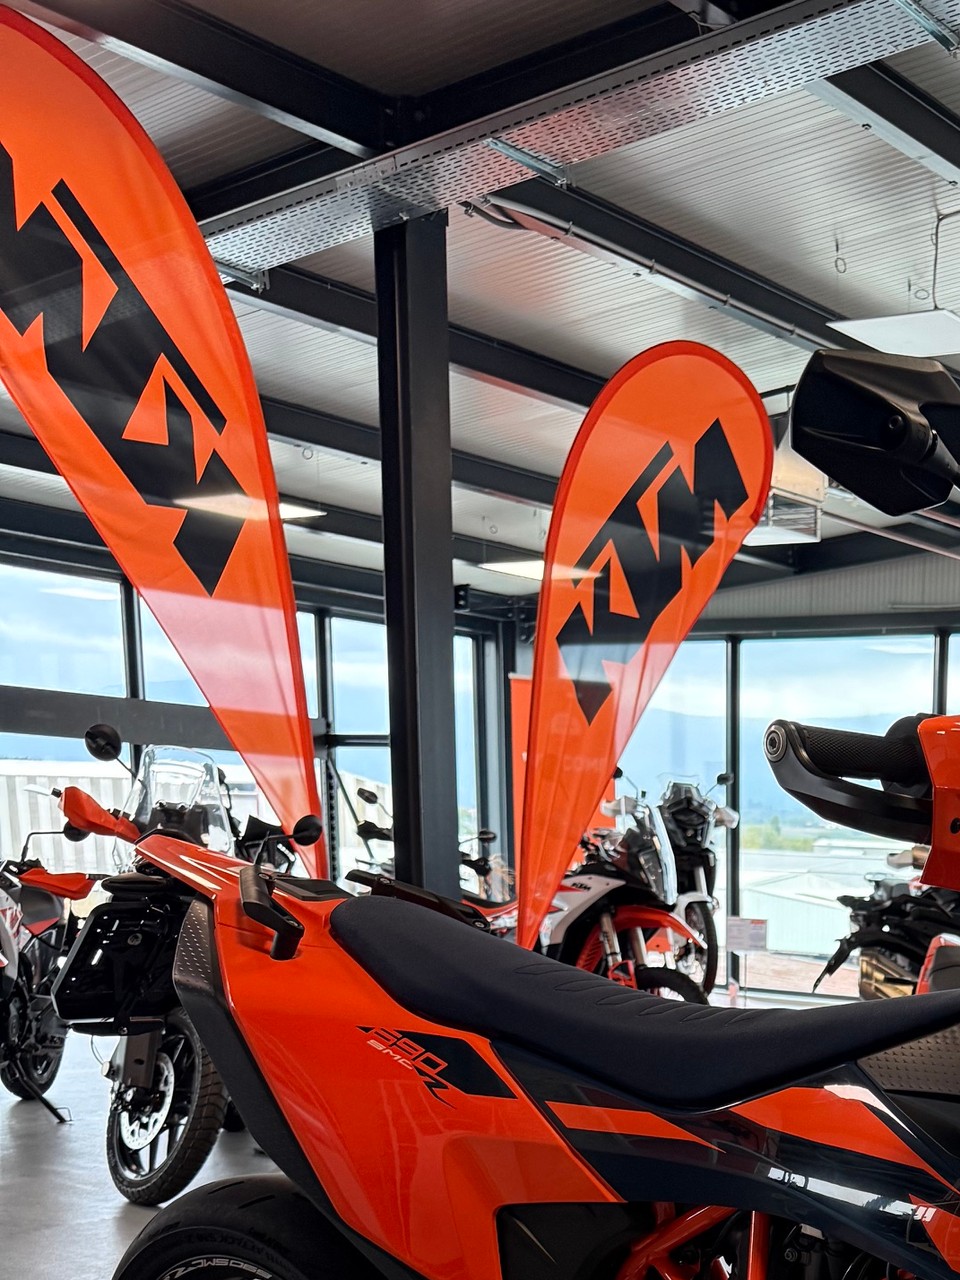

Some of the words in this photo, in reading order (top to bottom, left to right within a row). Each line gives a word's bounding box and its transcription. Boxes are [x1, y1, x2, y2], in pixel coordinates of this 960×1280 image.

[556, 417, 750, 726] KTM
[366, 1038, 414, 1070] SMC
[371, 1026, 449, 1076] 690
